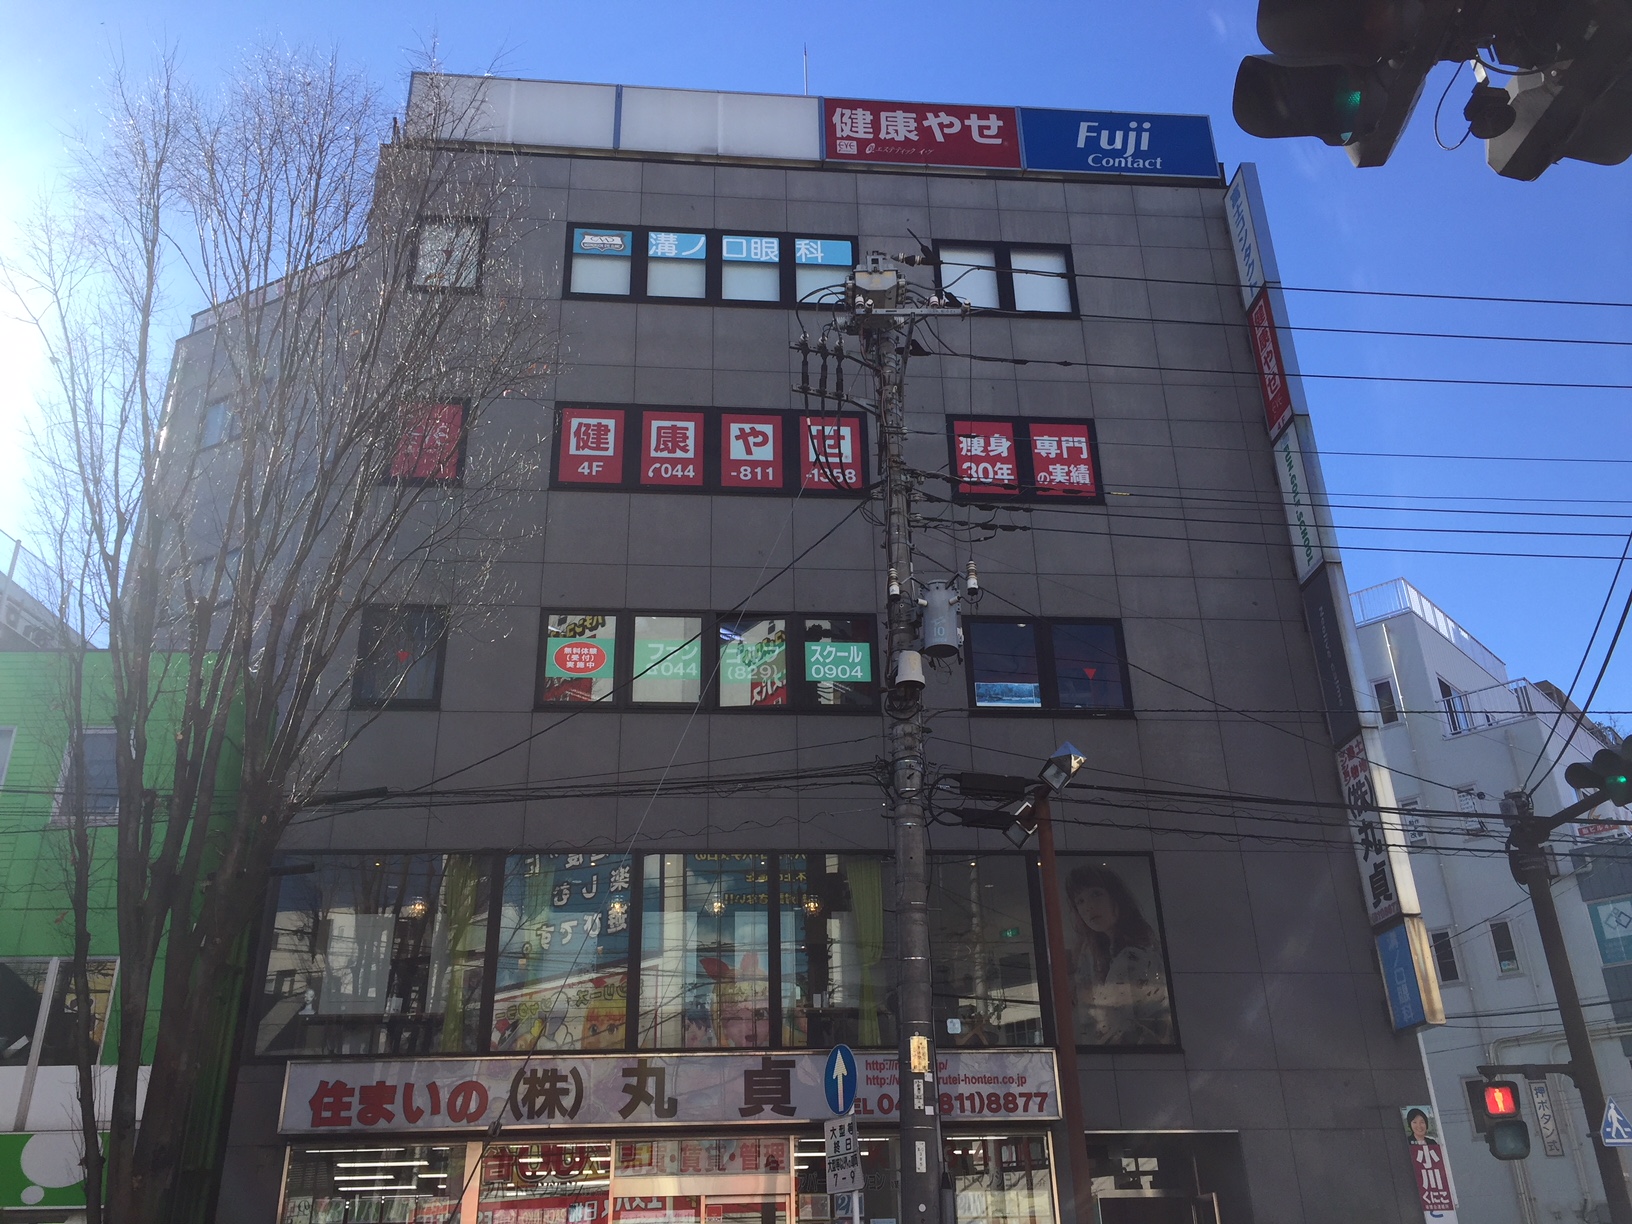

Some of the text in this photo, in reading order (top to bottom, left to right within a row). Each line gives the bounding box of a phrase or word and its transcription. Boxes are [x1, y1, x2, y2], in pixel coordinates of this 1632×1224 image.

[832, 107, 1004, 145] 健康やせ
[1077, 120, 1151, 157] Fuji
[1087, 153, 1162, 169] Contact
[959, 433, 1088, 459] 痩身 専門
[577, 461, 604, 476] 4F
[962, 461, 1091, 485] 30年 の実績
[563, 647, 598, 655] 無料体験
[810, 645, 862, 663] スクール
[566, 661, 595, 669] 実施中
[811, 664, 863, 679] 0904
[308, 1079, 489, 1128] 住まいの
[1533, 1086, 1560, 1152] 押ボタン式
[1416, 1145, 1444, 1190] 小川
[1422, 1191, 1450, 1204] くにこ
